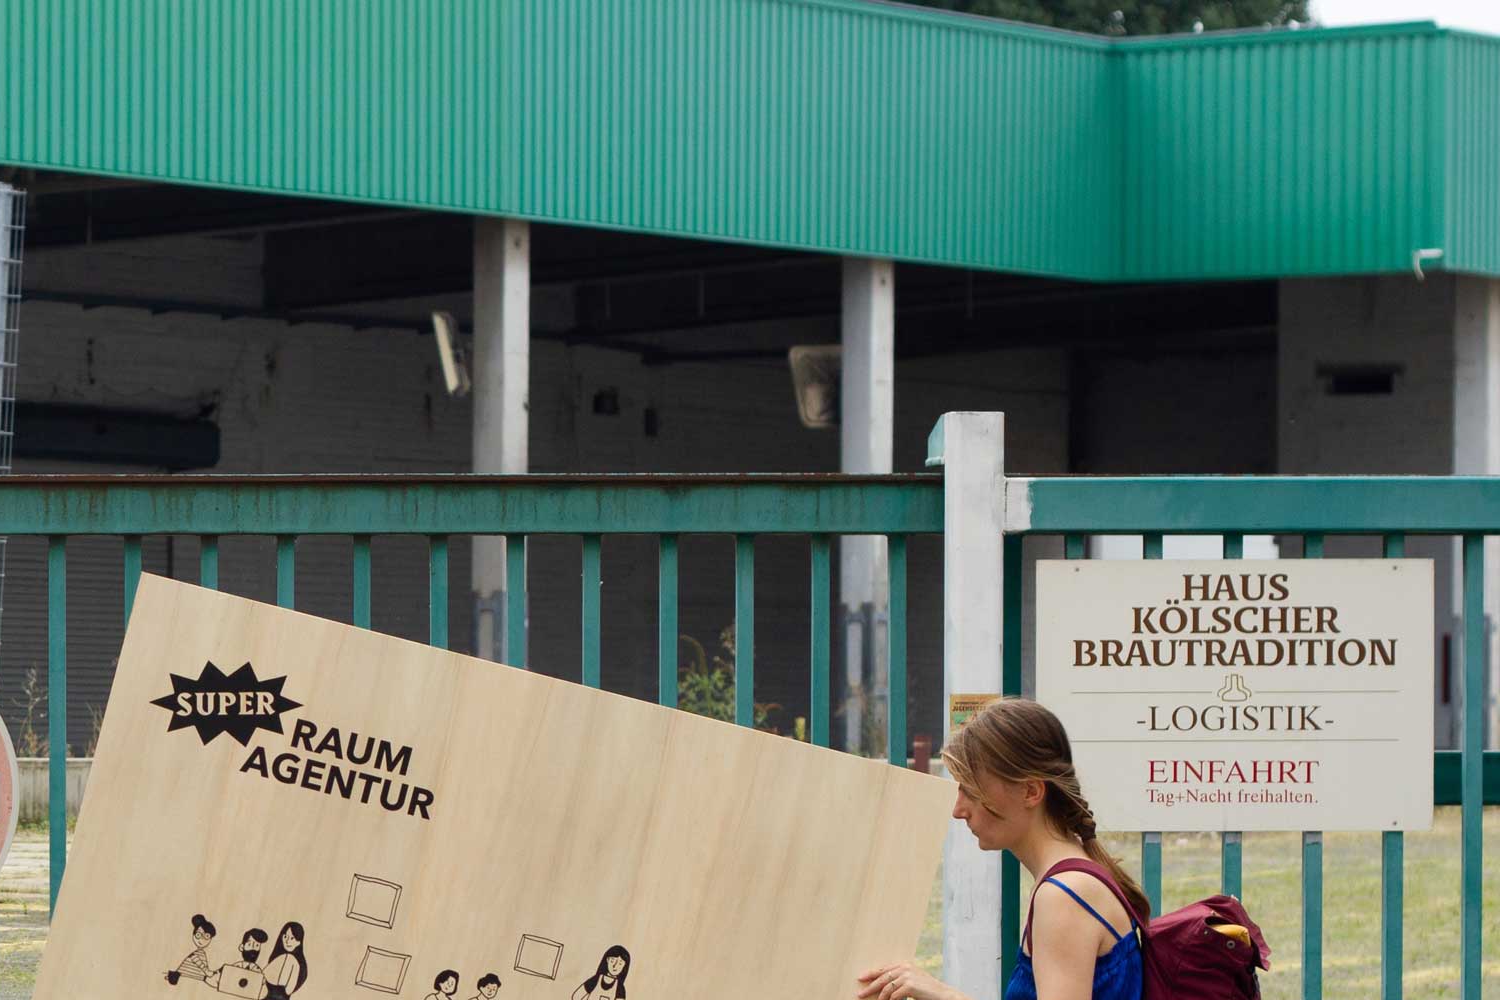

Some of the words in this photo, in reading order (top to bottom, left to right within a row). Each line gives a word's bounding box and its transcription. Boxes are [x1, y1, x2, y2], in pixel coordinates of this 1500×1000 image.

[1182, 574, 1290, 602] HAUS
[1131, 599, 1341, 634] KÖLSCHER
[1072, 639, 1398, 667] BRAUTRADITION
[175, 691, 276, 717] SUPER
[290, 718, 413, 776] RAUM
[239, 746, 435, 820] AGENTUR
[1148, 760, 1320, 784] EINFAHRT
[1147, 788, 1232, 806] Tag+Nacht
[1238, 788, 1319, 804] freihalten.
